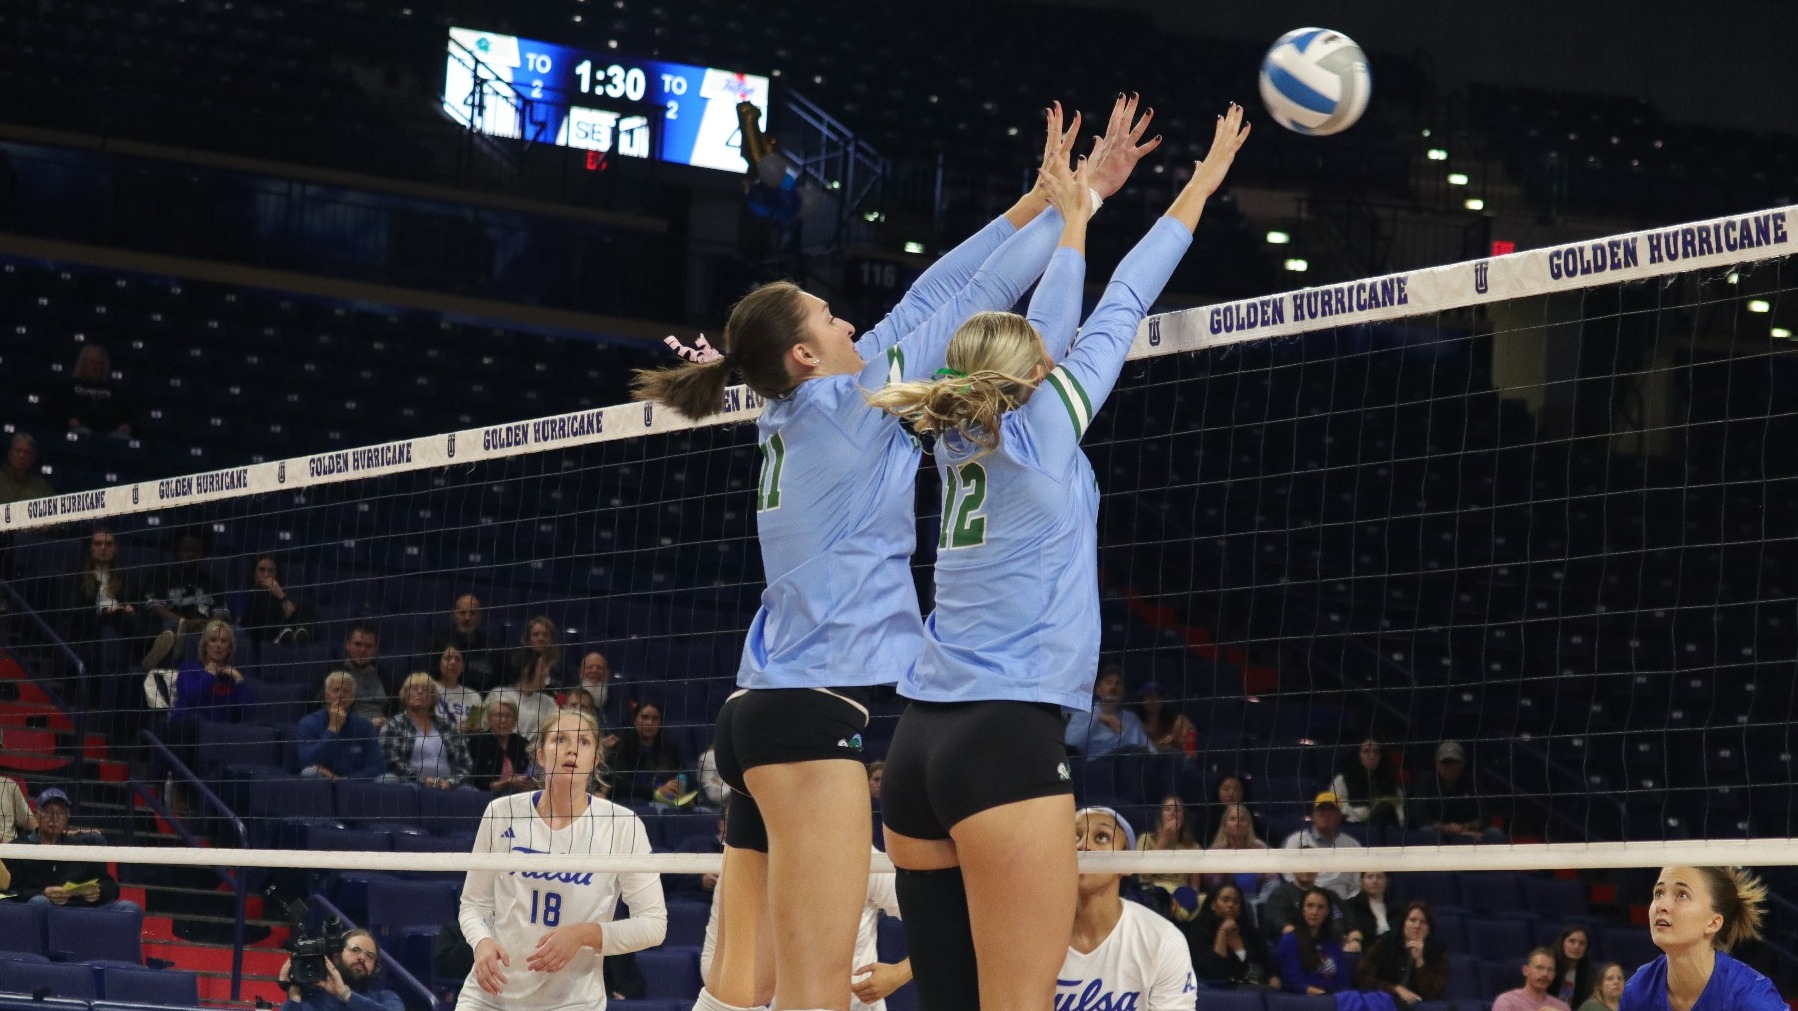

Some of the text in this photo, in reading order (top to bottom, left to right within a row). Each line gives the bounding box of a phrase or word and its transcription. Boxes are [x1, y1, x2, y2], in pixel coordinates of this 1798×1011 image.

[526, 52, 552, 74] TO
[531, 79, 544, 98] 2
[575, 59, 646, 101] 1:30
[661, 73, 687, 95] TO
[666, 101, 679, 120] 2
[576, 121, 612, 143] SE
[1549, 212, 1788, 281] GOLDEN HURRICANE
[860, 262, 897, 288] 116
[1209, 275, 1409, 336] GOLDEN HURRICANE
[483, 411, 603, 452] GOLDEN HURRICANE
[309, 442, 412, 478] GOLDEN HURRICANE
[757, 429, 785, 513] 11
[159, 468, 248, 500] GOLDEN HURRICANE
[27, 491, 106, 520] GOLDEN HURRICANE
[938, 461, 988, 550] 12
[530, 889, 562, 927] 18
[1054, 978, 1141, 1010] ulsa
